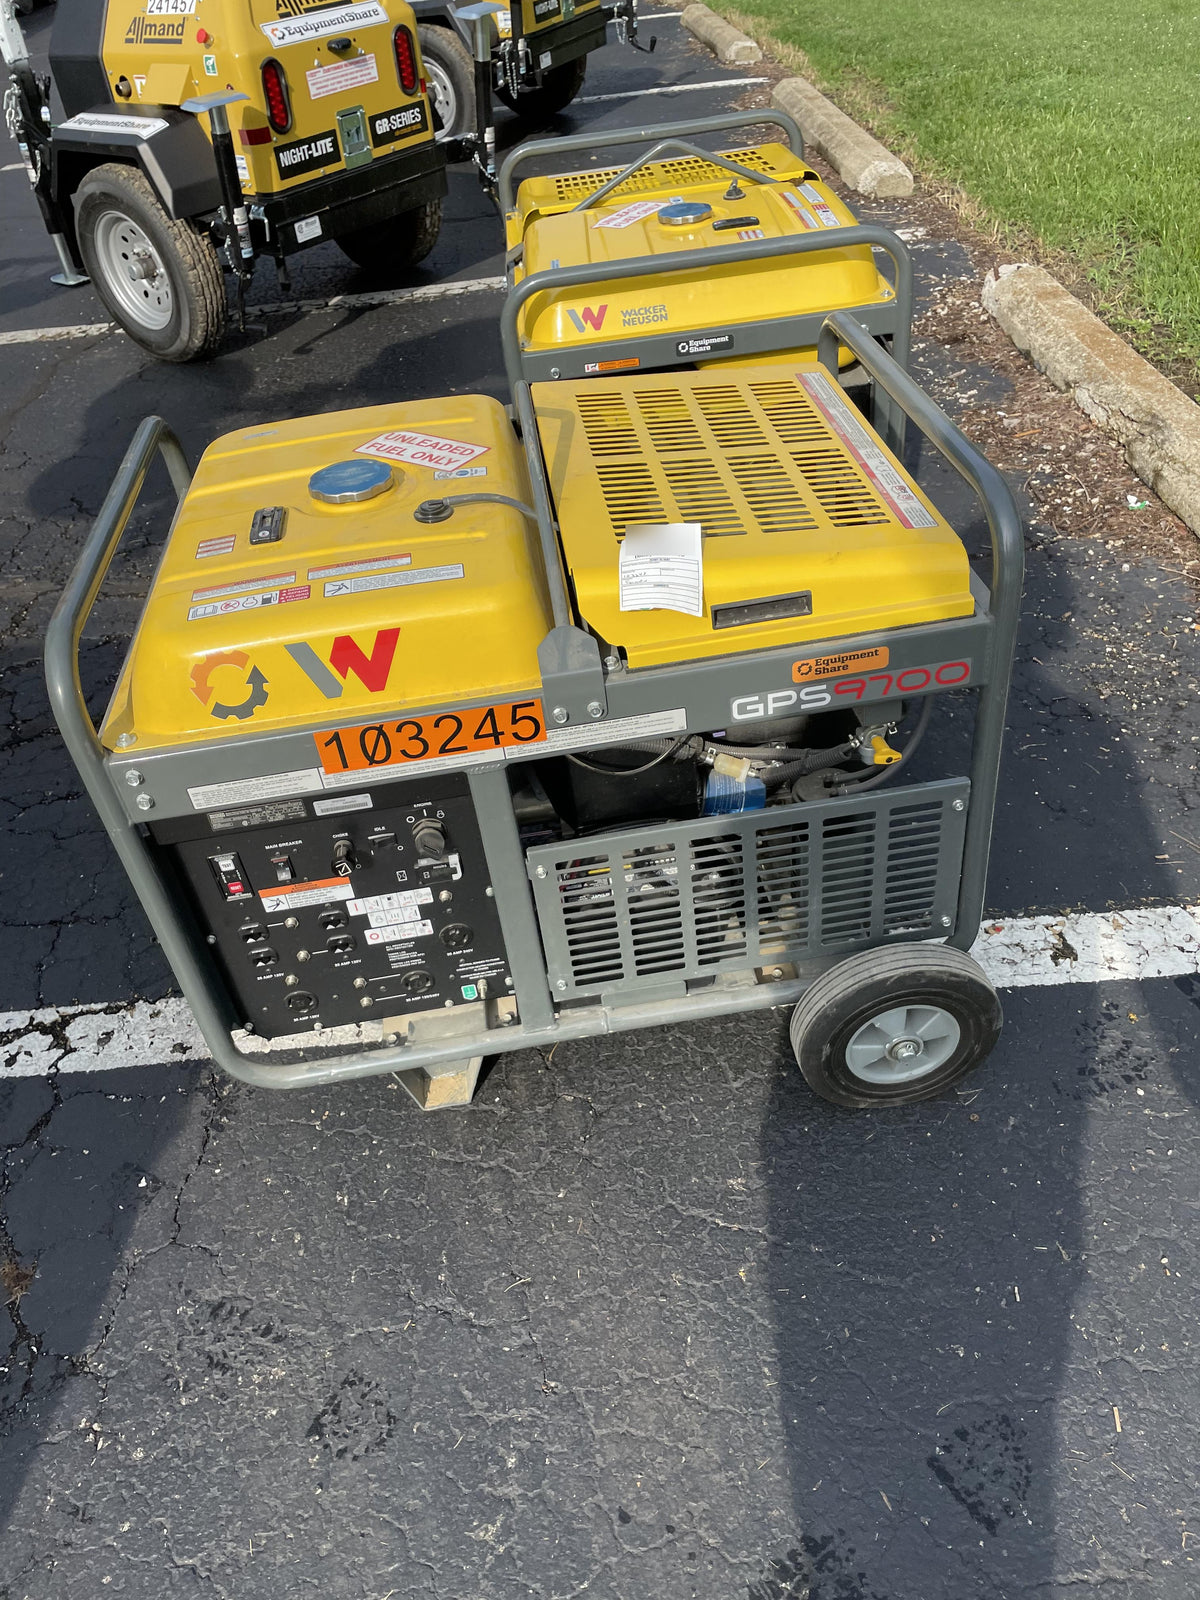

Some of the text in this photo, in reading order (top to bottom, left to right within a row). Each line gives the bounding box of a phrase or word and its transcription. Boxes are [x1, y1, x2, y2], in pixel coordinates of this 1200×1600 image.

[147, 0, 194, 14] 241457
[126, 16, 186, 44] Allmand
[284, 8, 380, 36] EquipmentShare
[375, 108, 421, 135] GR-SERIES
[279, 137, 334, 167] NIGHT-LITE
[620, 304, 667, 319] WACKER
[622, 313, 669, 327] NEUSON
[689, 335, 729, 347] Equipment
[689, 344, 711, 353] Share
[366, 442, 461, 466] FUEL ONLY
[384, 432, 475, 456] UNLEADED
[815, 649, 879, 667] Equipment
[815, 663, 849, 675] Share
[324, 702, 541, 769] 103245
